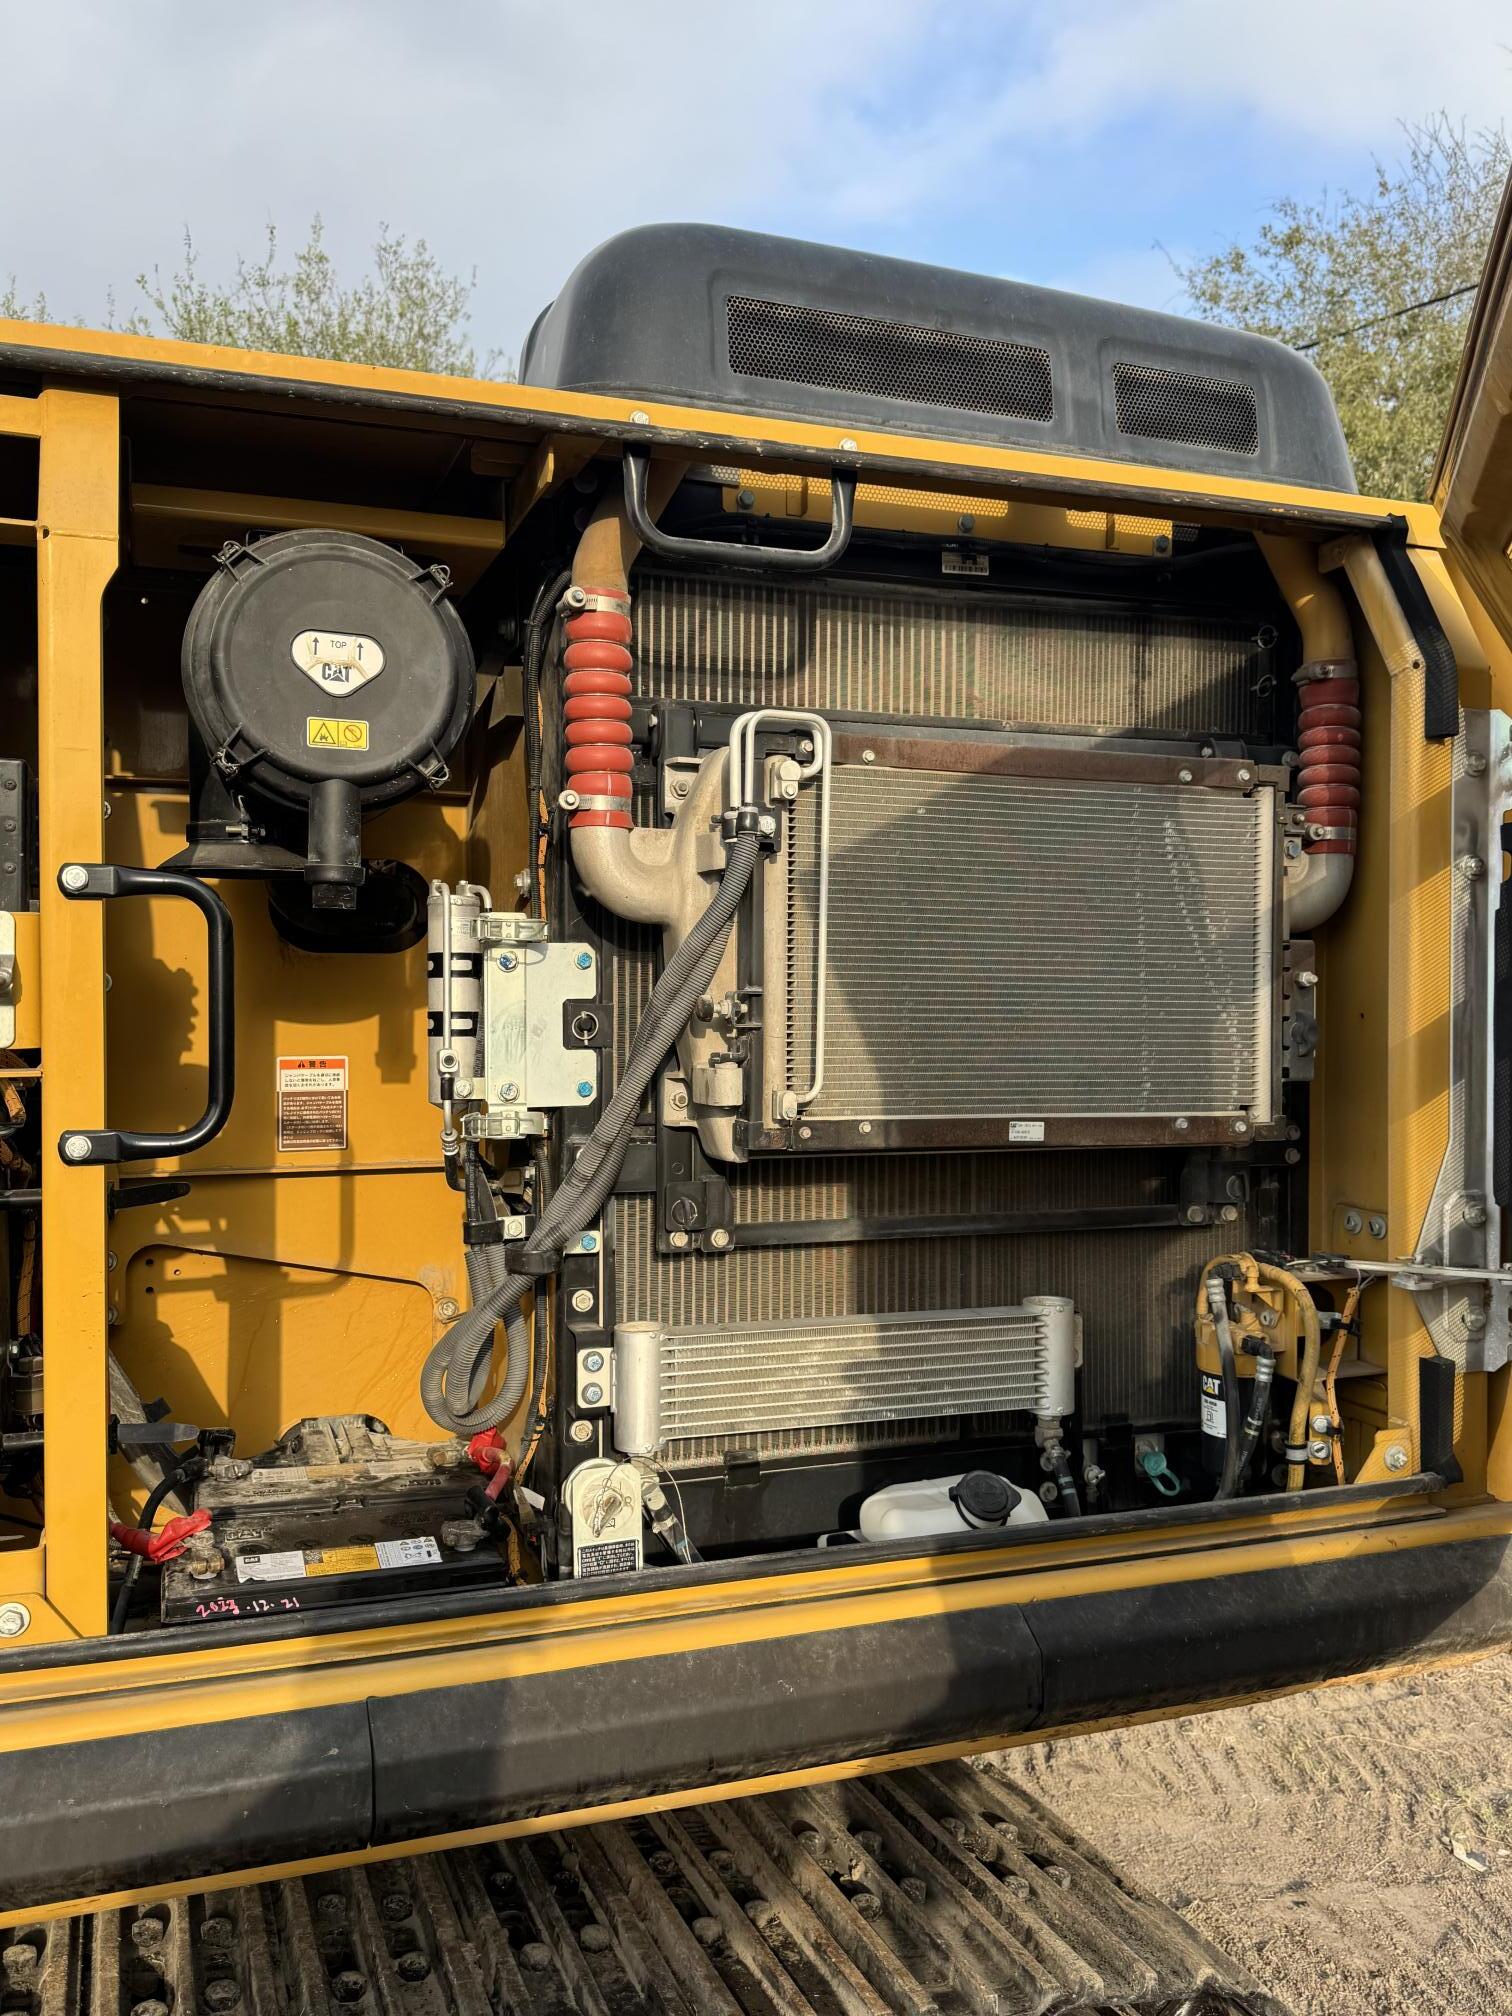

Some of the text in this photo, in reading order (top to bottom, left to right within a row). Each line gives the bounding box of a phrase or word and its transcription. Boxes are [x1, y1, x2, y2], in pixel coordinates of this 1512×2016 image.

[330, 640, 347, 649] TOP
[321, 662, 352, 683] CAT
[1202, 1375, 1221, 1396] CAT
